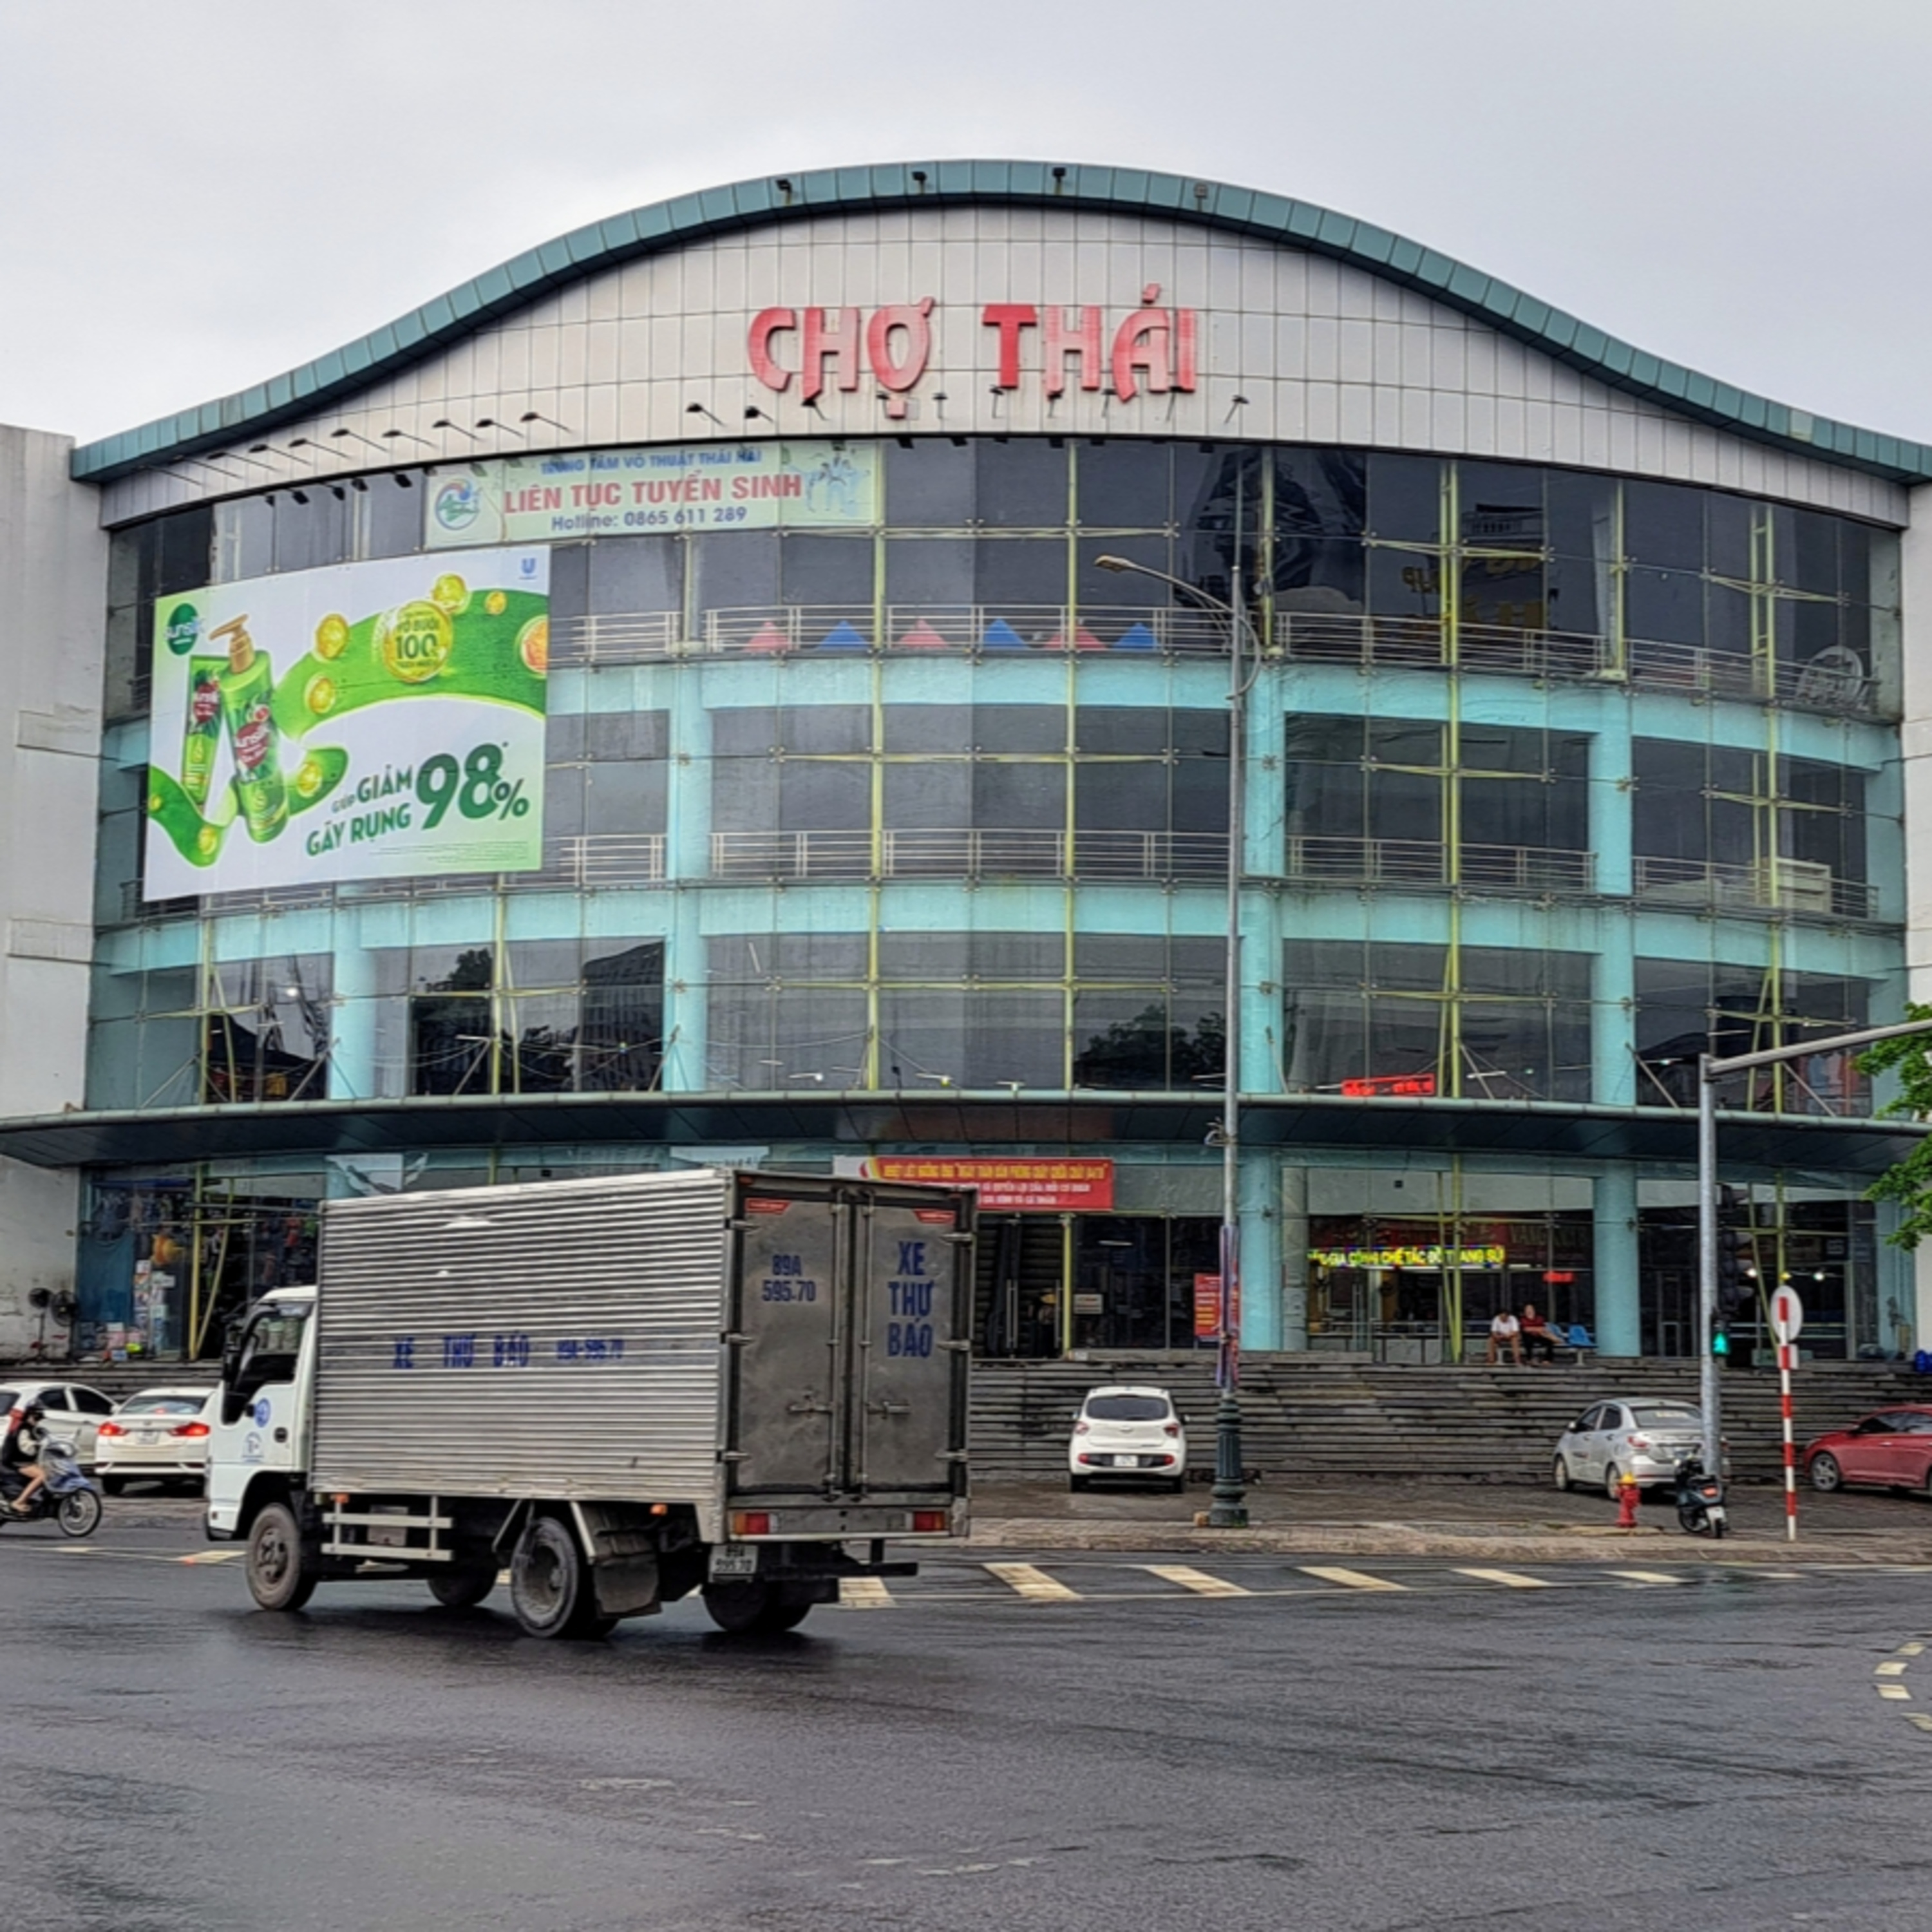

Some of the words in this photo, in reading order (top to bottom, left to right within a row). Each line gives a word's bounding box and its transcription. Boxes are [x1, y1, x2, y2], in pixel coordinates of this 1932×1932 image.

[748, 296, 935, 419] CHỢ
[982, 283, 1197, 403] THÁI
[505, 484, 562, 513] LIÊN
[571, 482, 621, 511] TỤC
[632, 469, 722, 504] TUYỂN
[732, 474, 802, 499] SINH
[624, 509, 668, 527] 0865
[674, 507, 706, 525] 611
[714, 506, 747, 522] 289
[357, 763, 413, 804] GIẢM
[306, 820, 346, 858] GÃY
[350, 802, 412, 843] RỤNG
[897, 1240, 927, 1276] XE
